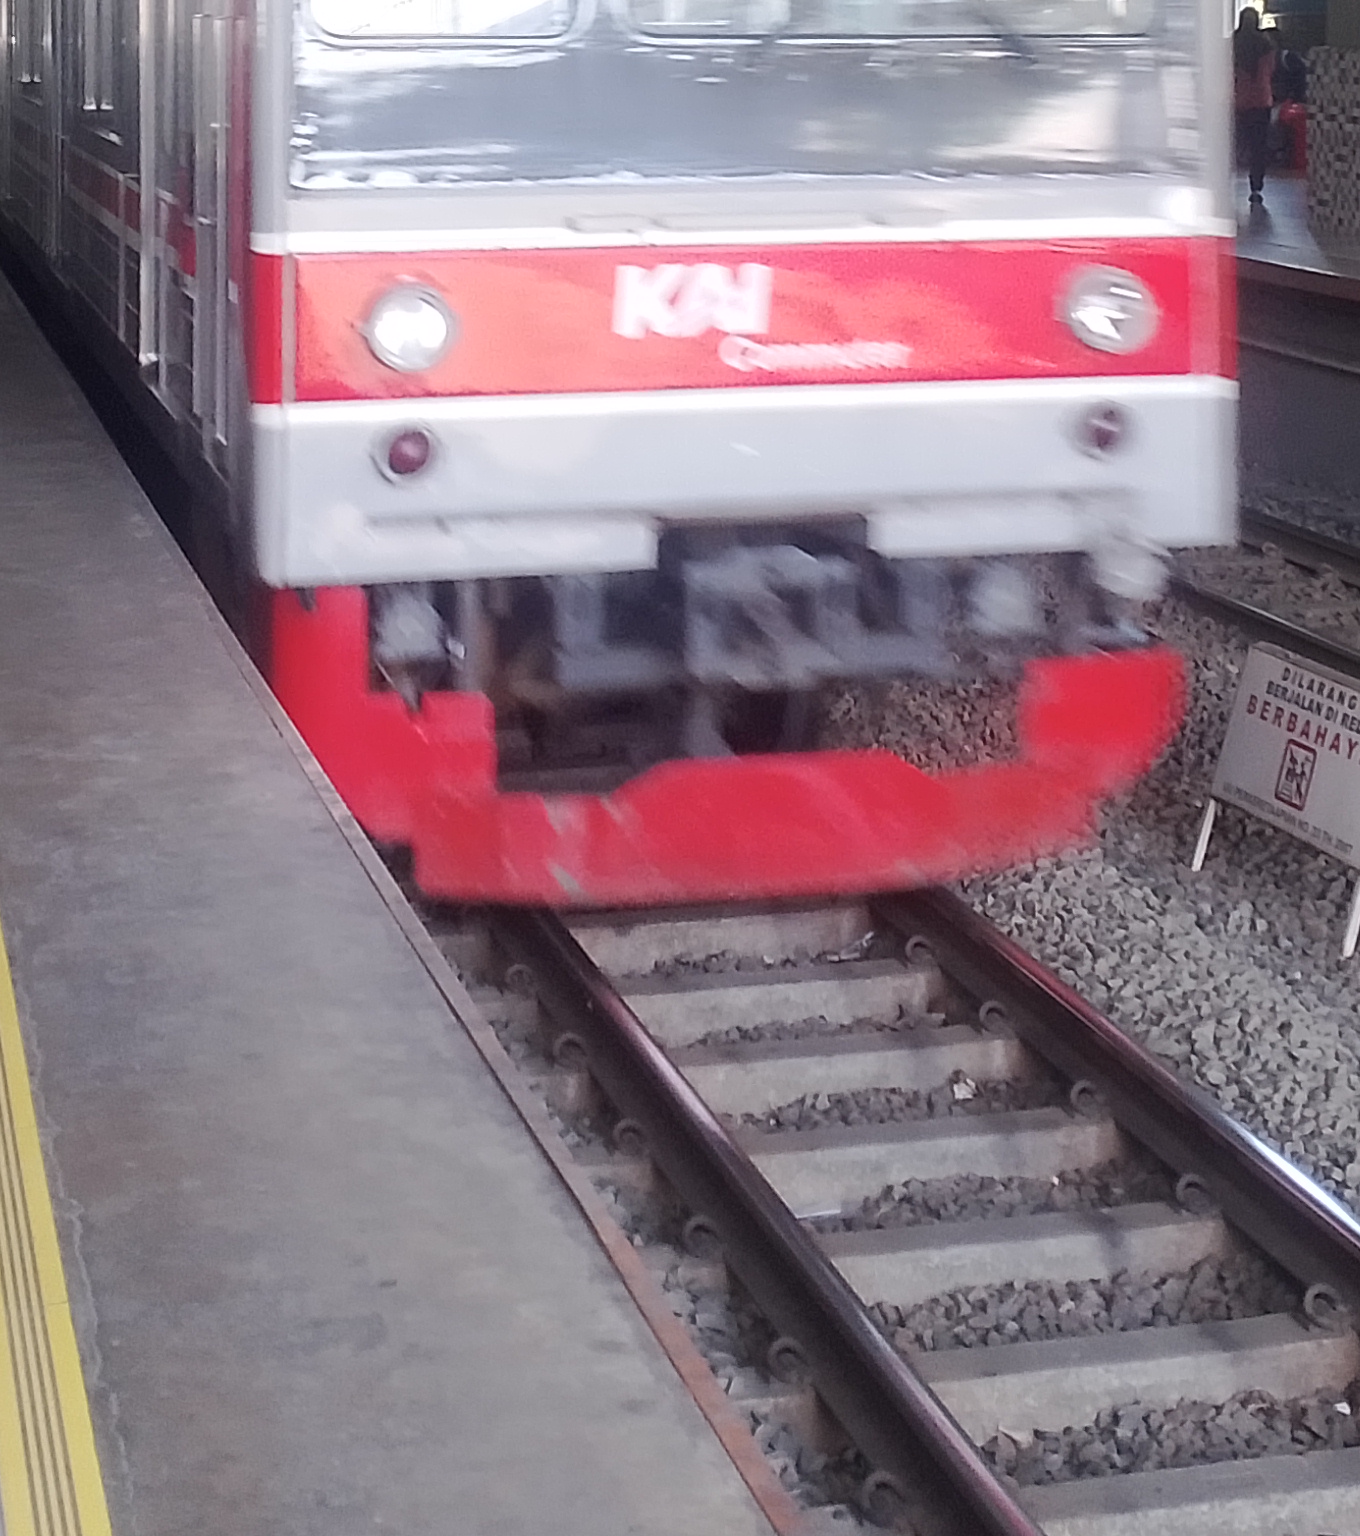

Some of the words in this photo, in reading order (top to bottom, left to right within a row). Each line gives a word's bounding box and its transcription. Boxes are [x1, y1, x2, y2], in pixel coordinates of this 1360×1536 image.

[612, 263, 774, 339] KAI
[1266, 680, 1326, 716] BERJALAN
[1324, 706, 1340, 724] DI
[1281, 667, 1358, 710] DILARANG
